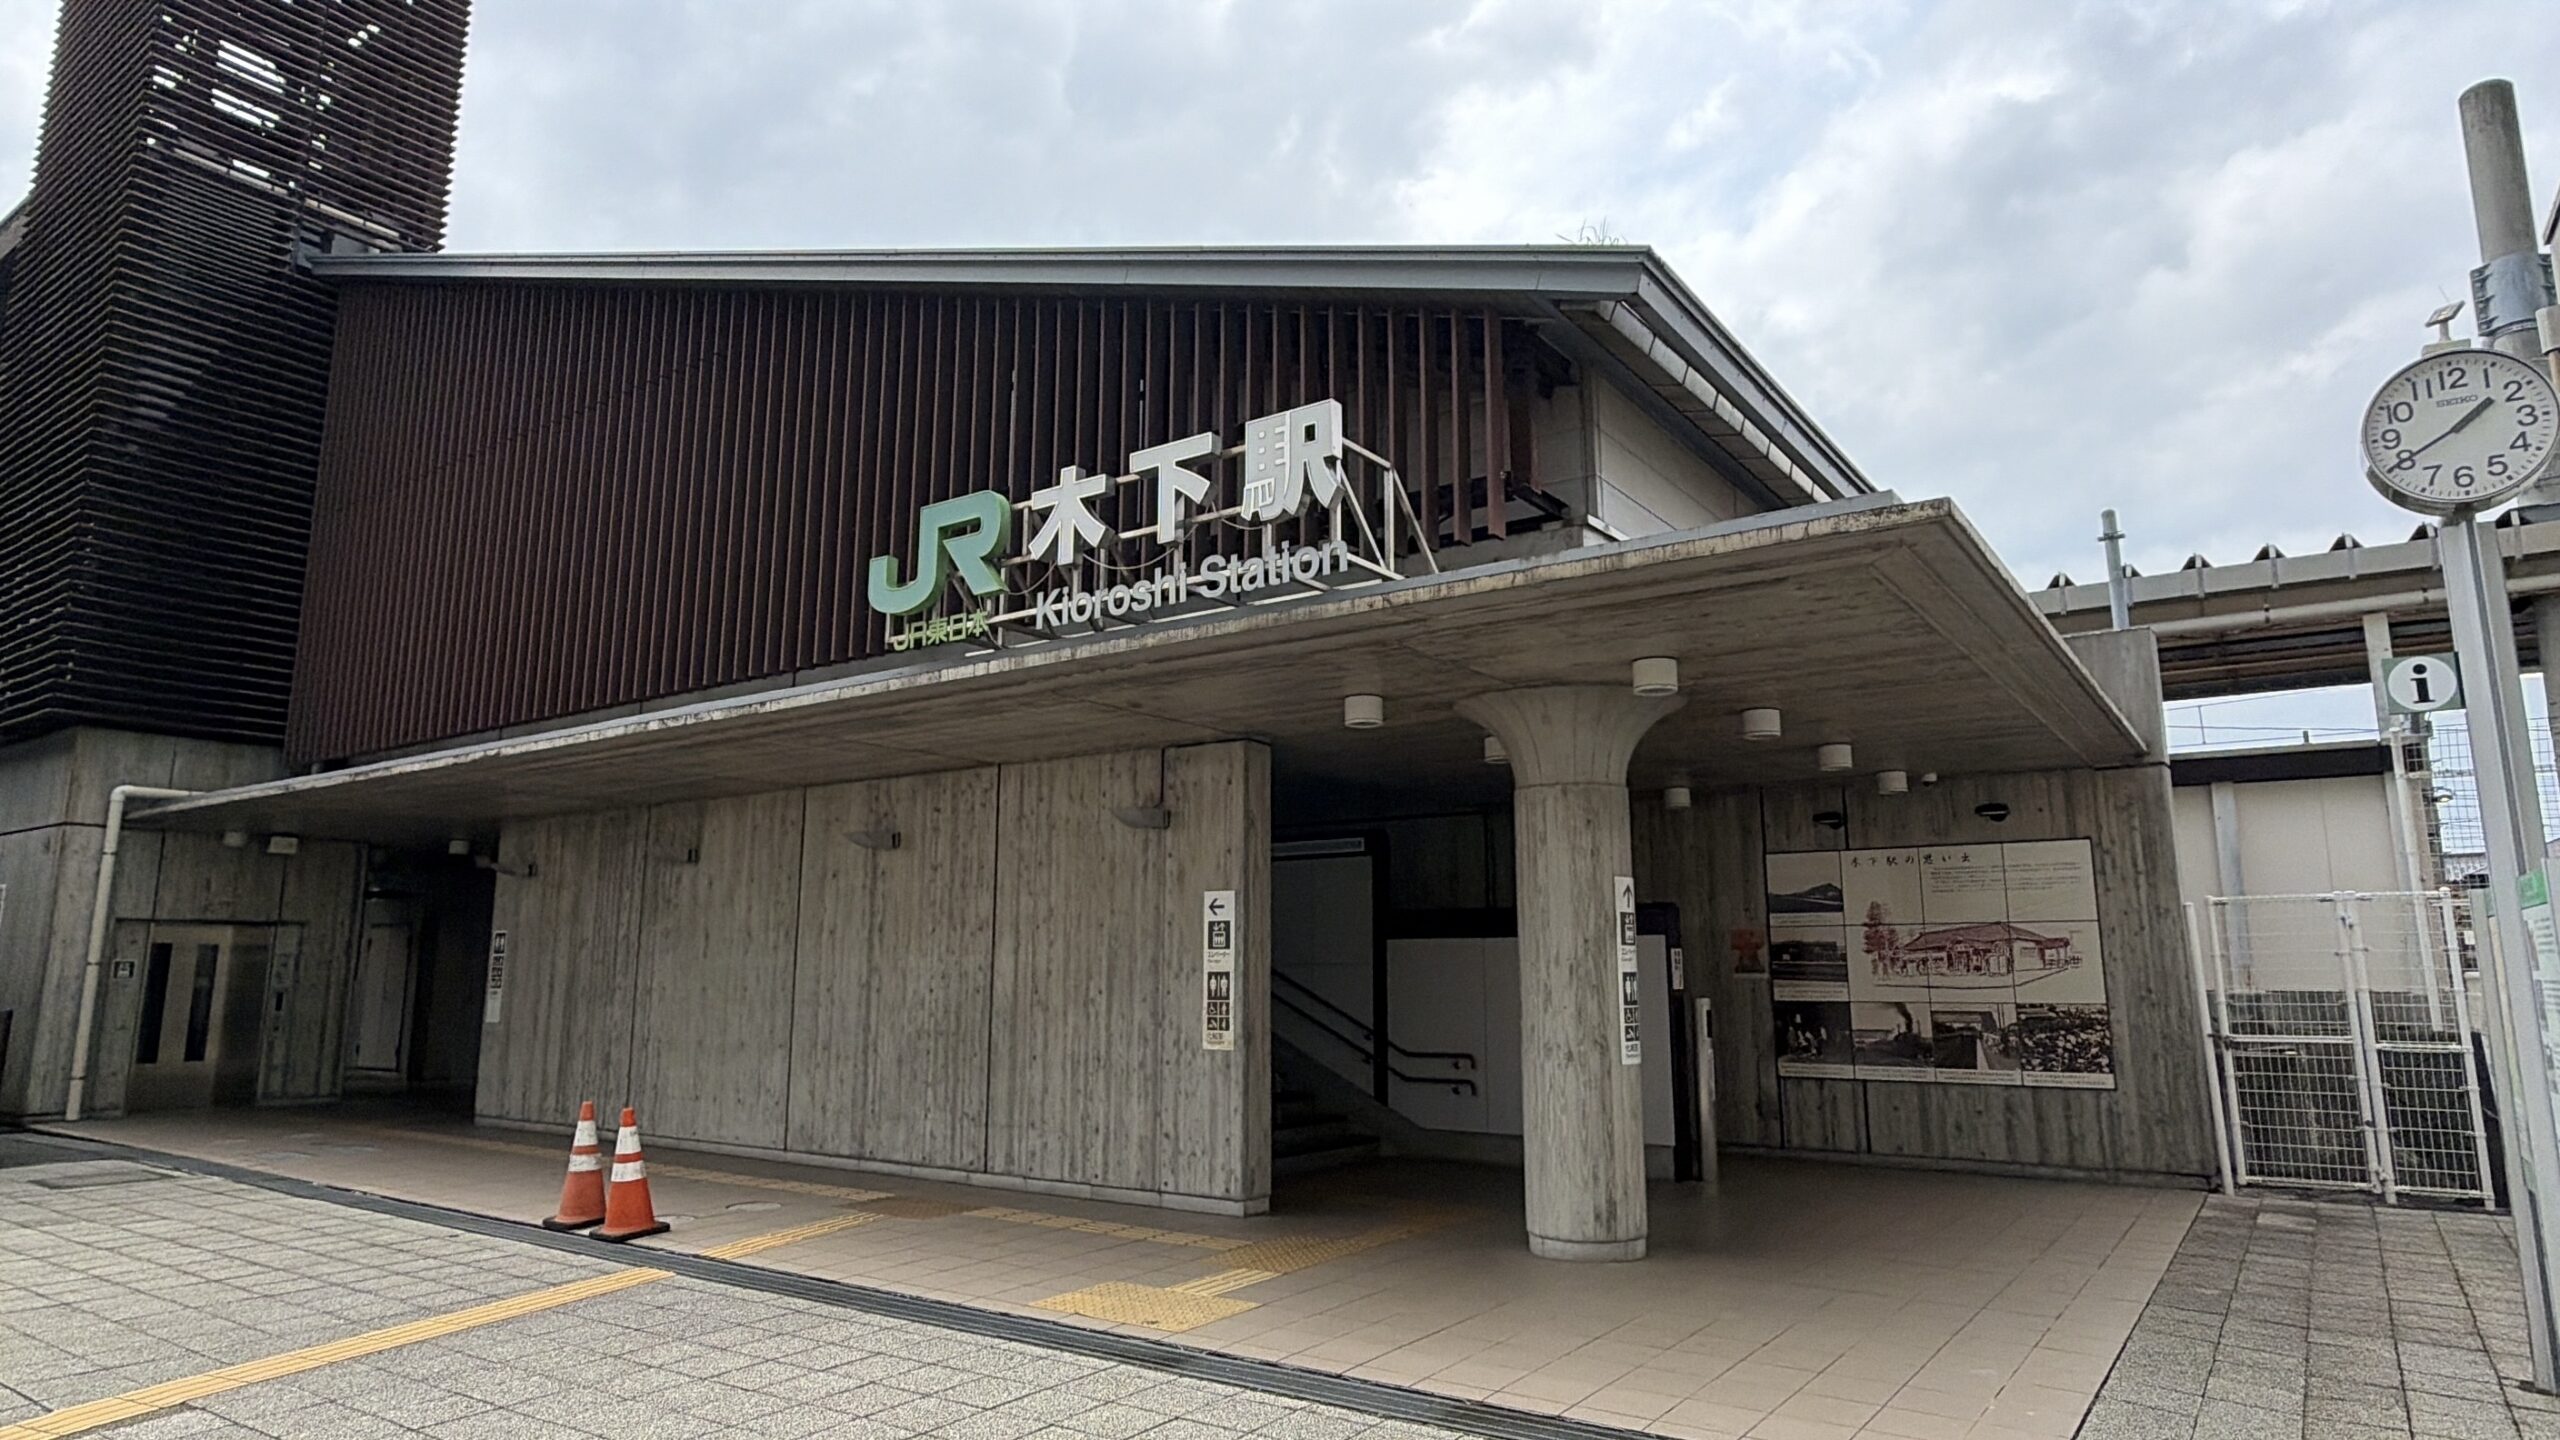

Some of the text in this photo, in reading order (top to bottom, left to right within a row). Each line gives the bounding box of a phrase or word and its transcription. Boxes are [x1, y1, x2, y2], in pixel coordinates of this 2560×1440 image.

[2438, 367, 2468, 390] 12
[2483, 367, 2491, 388] 1
[2411, 378, 2433, 401] 11
[2503, 380, 2525, 402] 2
[2436, 395, 2478, 407] SEIKO
[2386, 402, 2414, 424] 10
[2516, 404, 2539, 426] 3
[2381, 428, 2401, 450] 9
[2509, 431, 2532, 452] 4
[2396, 449, 2416, 471] 8
[2487, 454, 2508, 476] 5
[1029, 398, 1344, 566] 木下駅
[2422, 464, 2443, 486] 7
[2453, 466, 2475, 487] 6
[868, 489, 1011, 617] JR
[1035, 540, 1348, 630] Kioroshi Station
[893, 608, 989, 652] JR東日本
